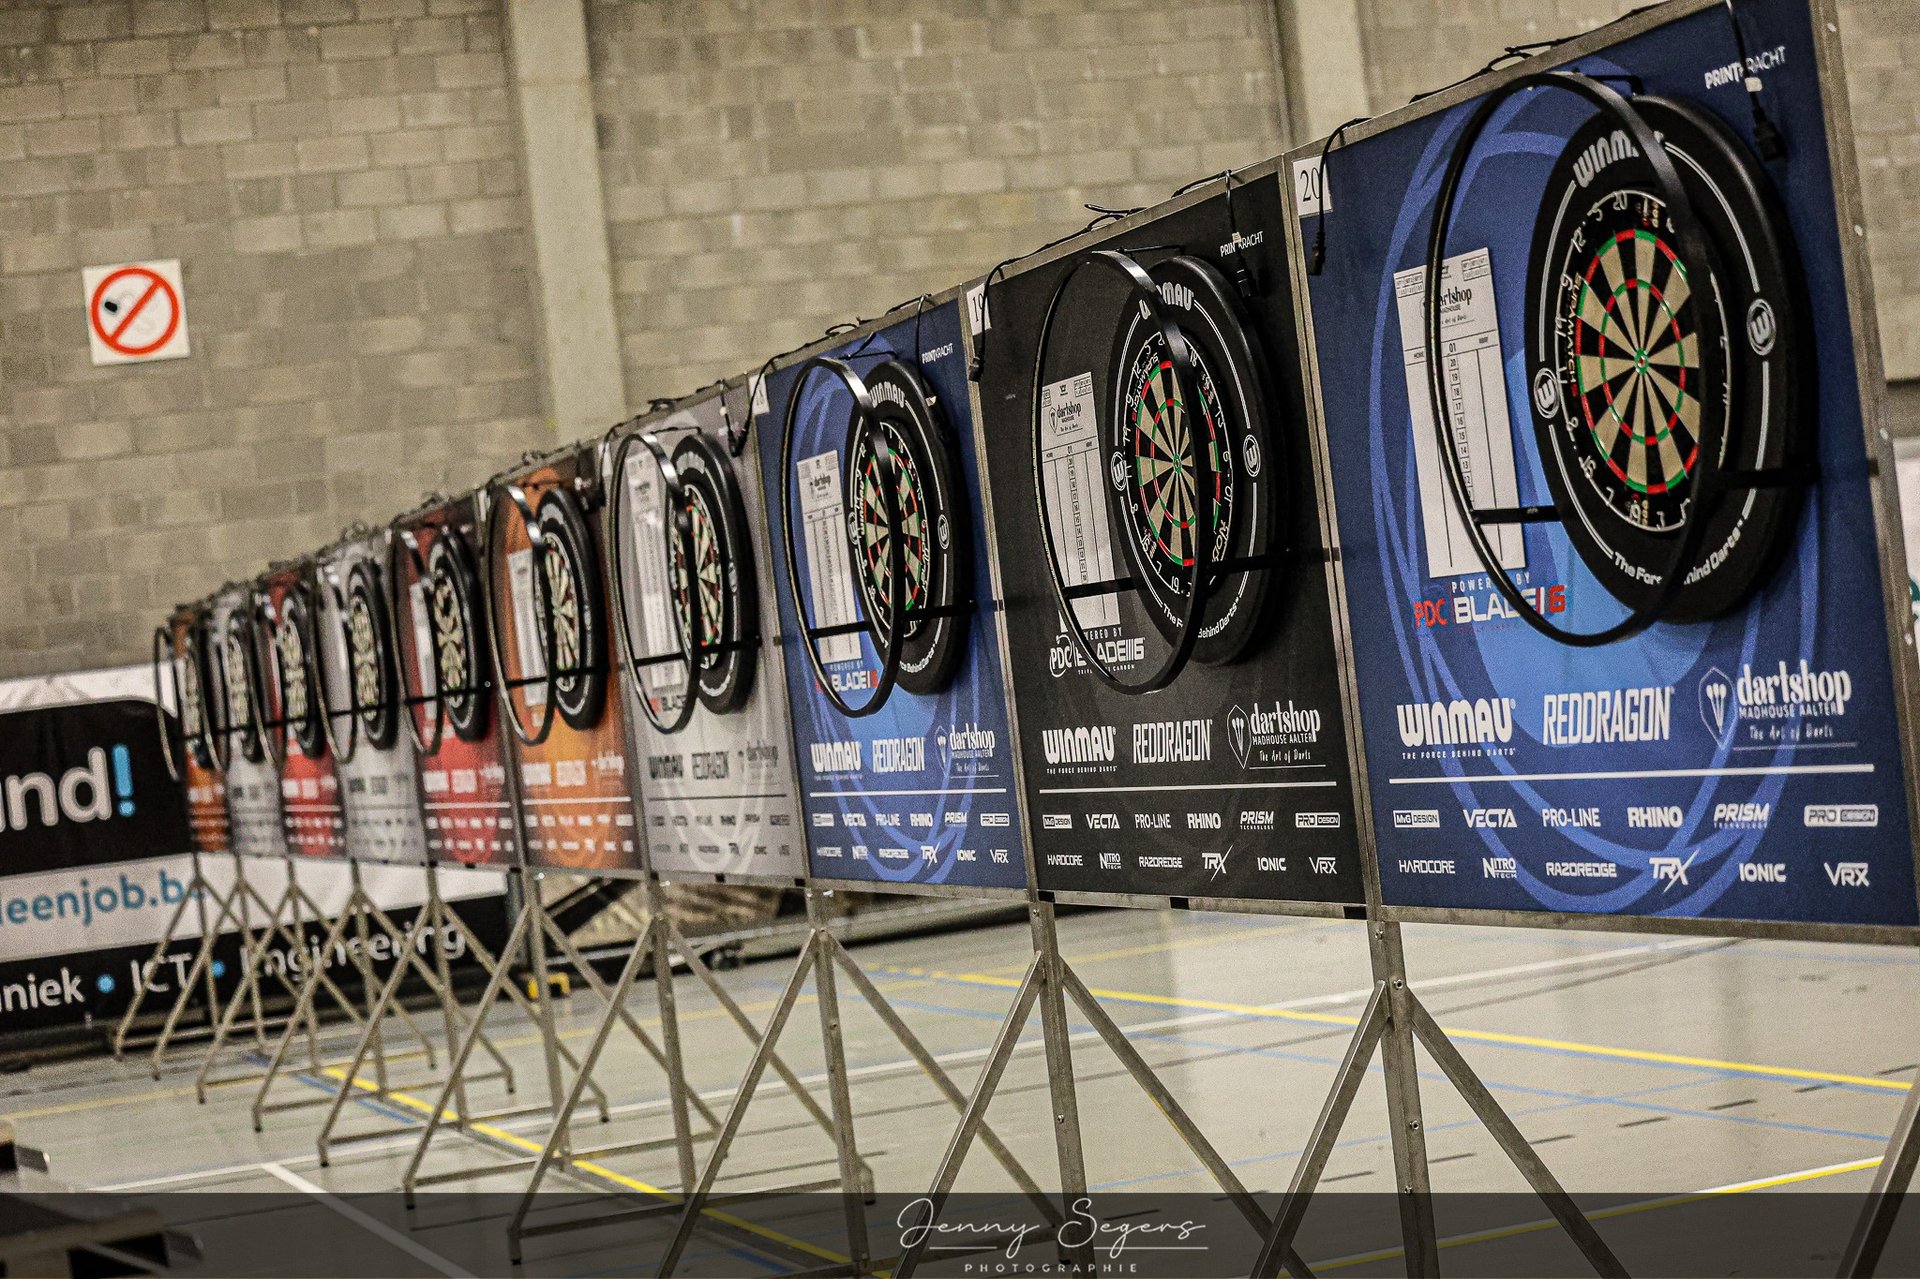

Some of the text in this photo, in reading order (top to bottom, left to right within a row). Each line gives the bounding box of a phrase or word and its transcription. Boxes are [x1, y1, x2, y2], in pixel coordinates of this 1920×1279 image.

[1300, 167, 1321, 202] 20
[1615, 552, 1636, 581] The
[1516, 572, 1530, 586] BY
[1414, 598, 1448, 629] PDC
[1113, 626, 1122, 637] BY
[1737, 659, 1851, 715] dartshop
[1543, 687, 1671, 745] REDDRAGON
[1739, 705, 1795, 719] MADHOUSE
[1250, 700, 1320, 742] dartshop
[950, 722, 995, 757] dartshop
[1133, 719, 1211, 764] REDDRAGON
[1252, 734, 1287, 745] MADHOUSE
[872, 737, 925, 773] REDDRAGON
[0, 744, 136, 833] nd!
[945, 812, 967, 823] PRISM
[1086, 813, 1120, 829] VECTA
[1135, 813, 1171, 828] PRO-LINE
[1187, 812, 1221, 829] RHINO
[1240, 811, 1274, 824] PRISM
[1413, 813, 1438, 824] DESIGN
[1463, 808, 1517, 828] VECTA
[1542, 808, 1601, 827] PRO-LINE
[1627, 805, 1683, 828] RHINO
[1714, 803, 1770, 822] PRISM
[1808, 809, 1838, 822] PRO
[957, 850, 976, 861] IONIC
[990, 849, 1009, 864] VRX
[1047, 854, 1083, 866] HARDCORE
[1139, 857, 1183, 868] RAZOREDGE
[1257, 857, 1287, 871] IONIC
[1309, 857, 1337, 874] VRX
[1399, 860, 1455, 875] HARDCORE
[1482, 858, 1516, 879] NITRO
[1546, 862, 1617, 878] RAZOREDGE
[1738, 863, 1787, 883] IONIC
[1823, 862, 1870, 887] VRX
